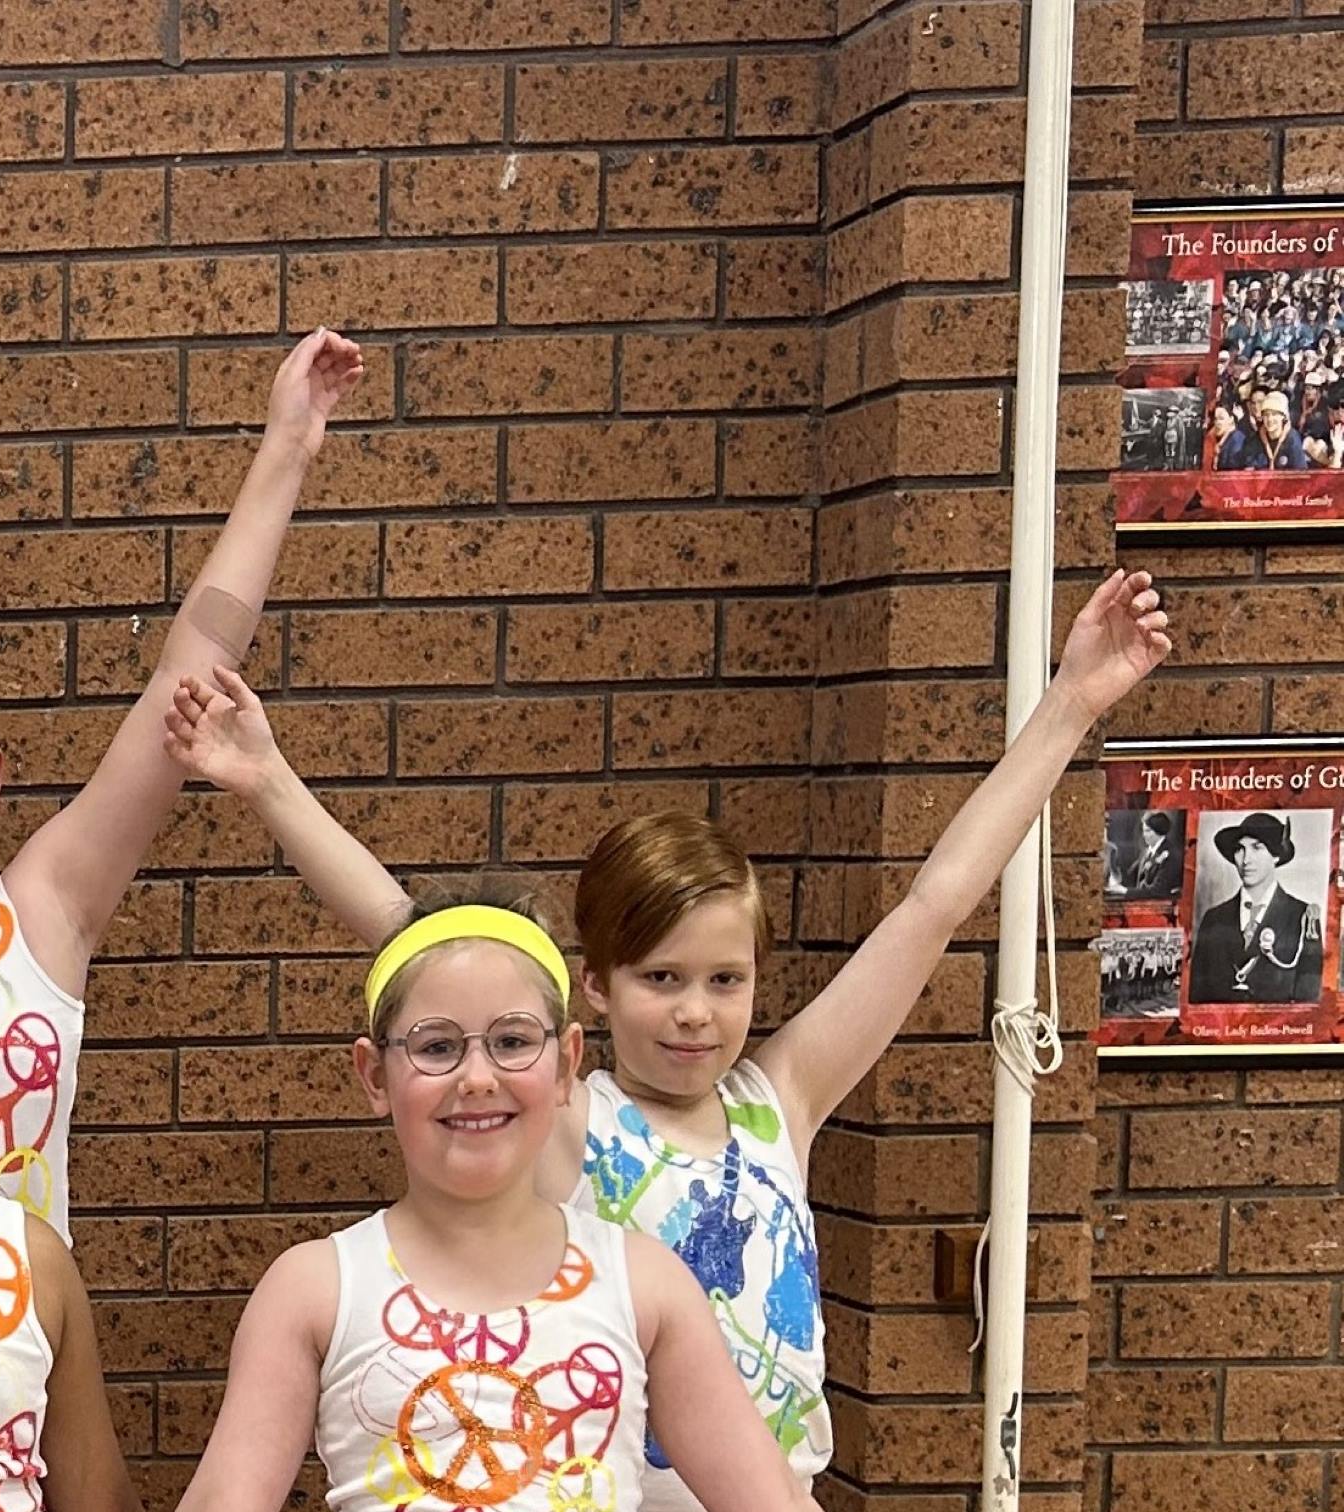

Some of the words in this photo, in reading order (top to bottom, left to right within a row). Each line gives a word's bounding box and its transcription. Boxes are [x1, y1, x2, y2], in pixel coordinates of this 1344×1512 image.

[1162, 232, 1205, 257] The
[1211, 229, 1307, 255] Founders
[1313, 227, 1339, 252] of
[1141, 769, 1183, 792] The
[1189, 766, 1284, 791] Founders
[1289, 764, 1315, 789] of
